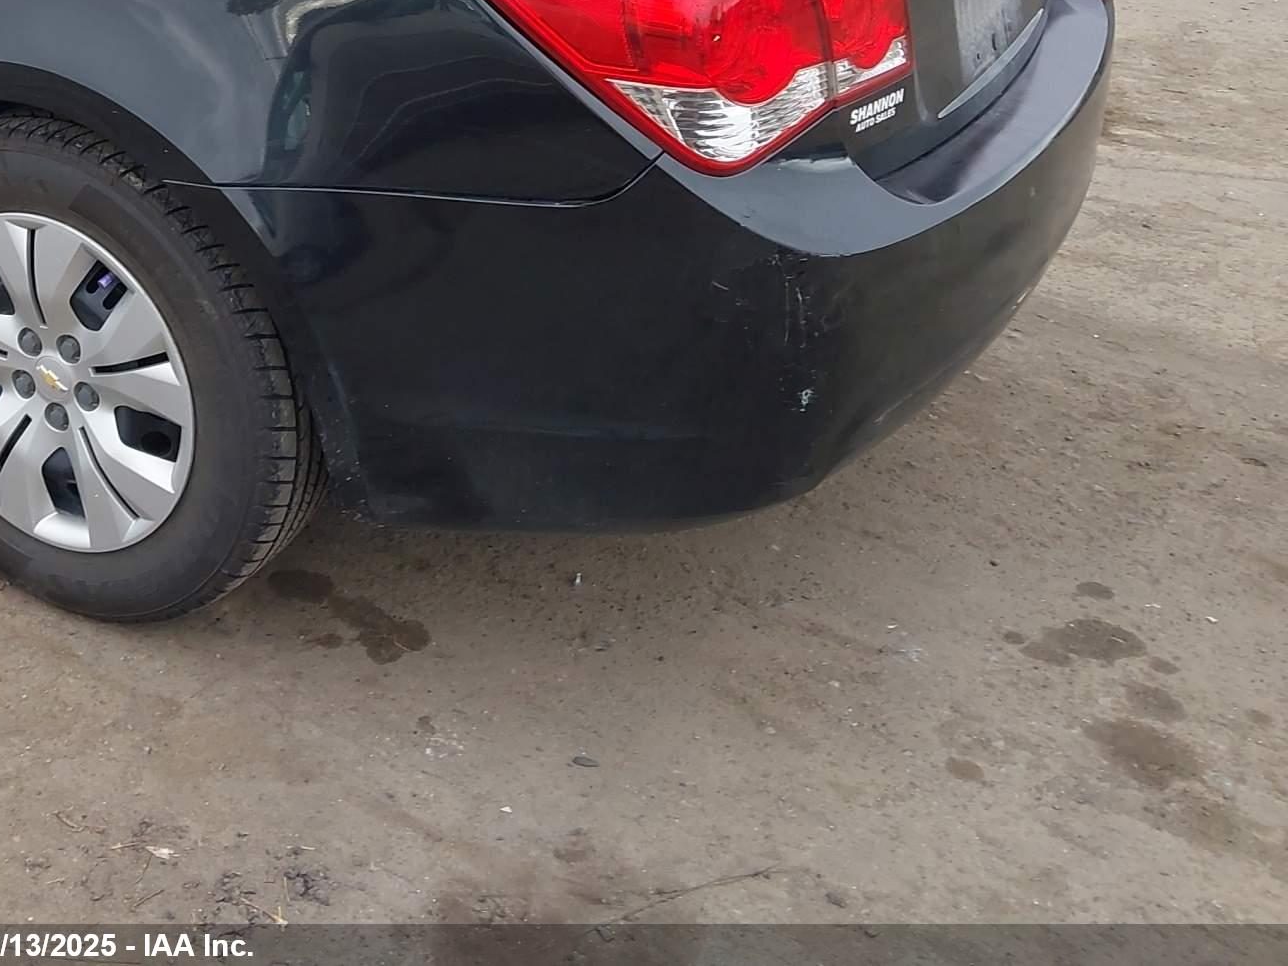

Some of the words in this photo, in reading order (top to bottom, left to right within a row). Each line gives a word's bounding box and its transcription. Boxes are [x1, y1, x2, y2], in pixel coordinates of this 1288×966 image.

[849, 87, 905, 125] SHANNON
[855, 117, 875, 133] AUTO
[875, 107, 896, 123] SALES
